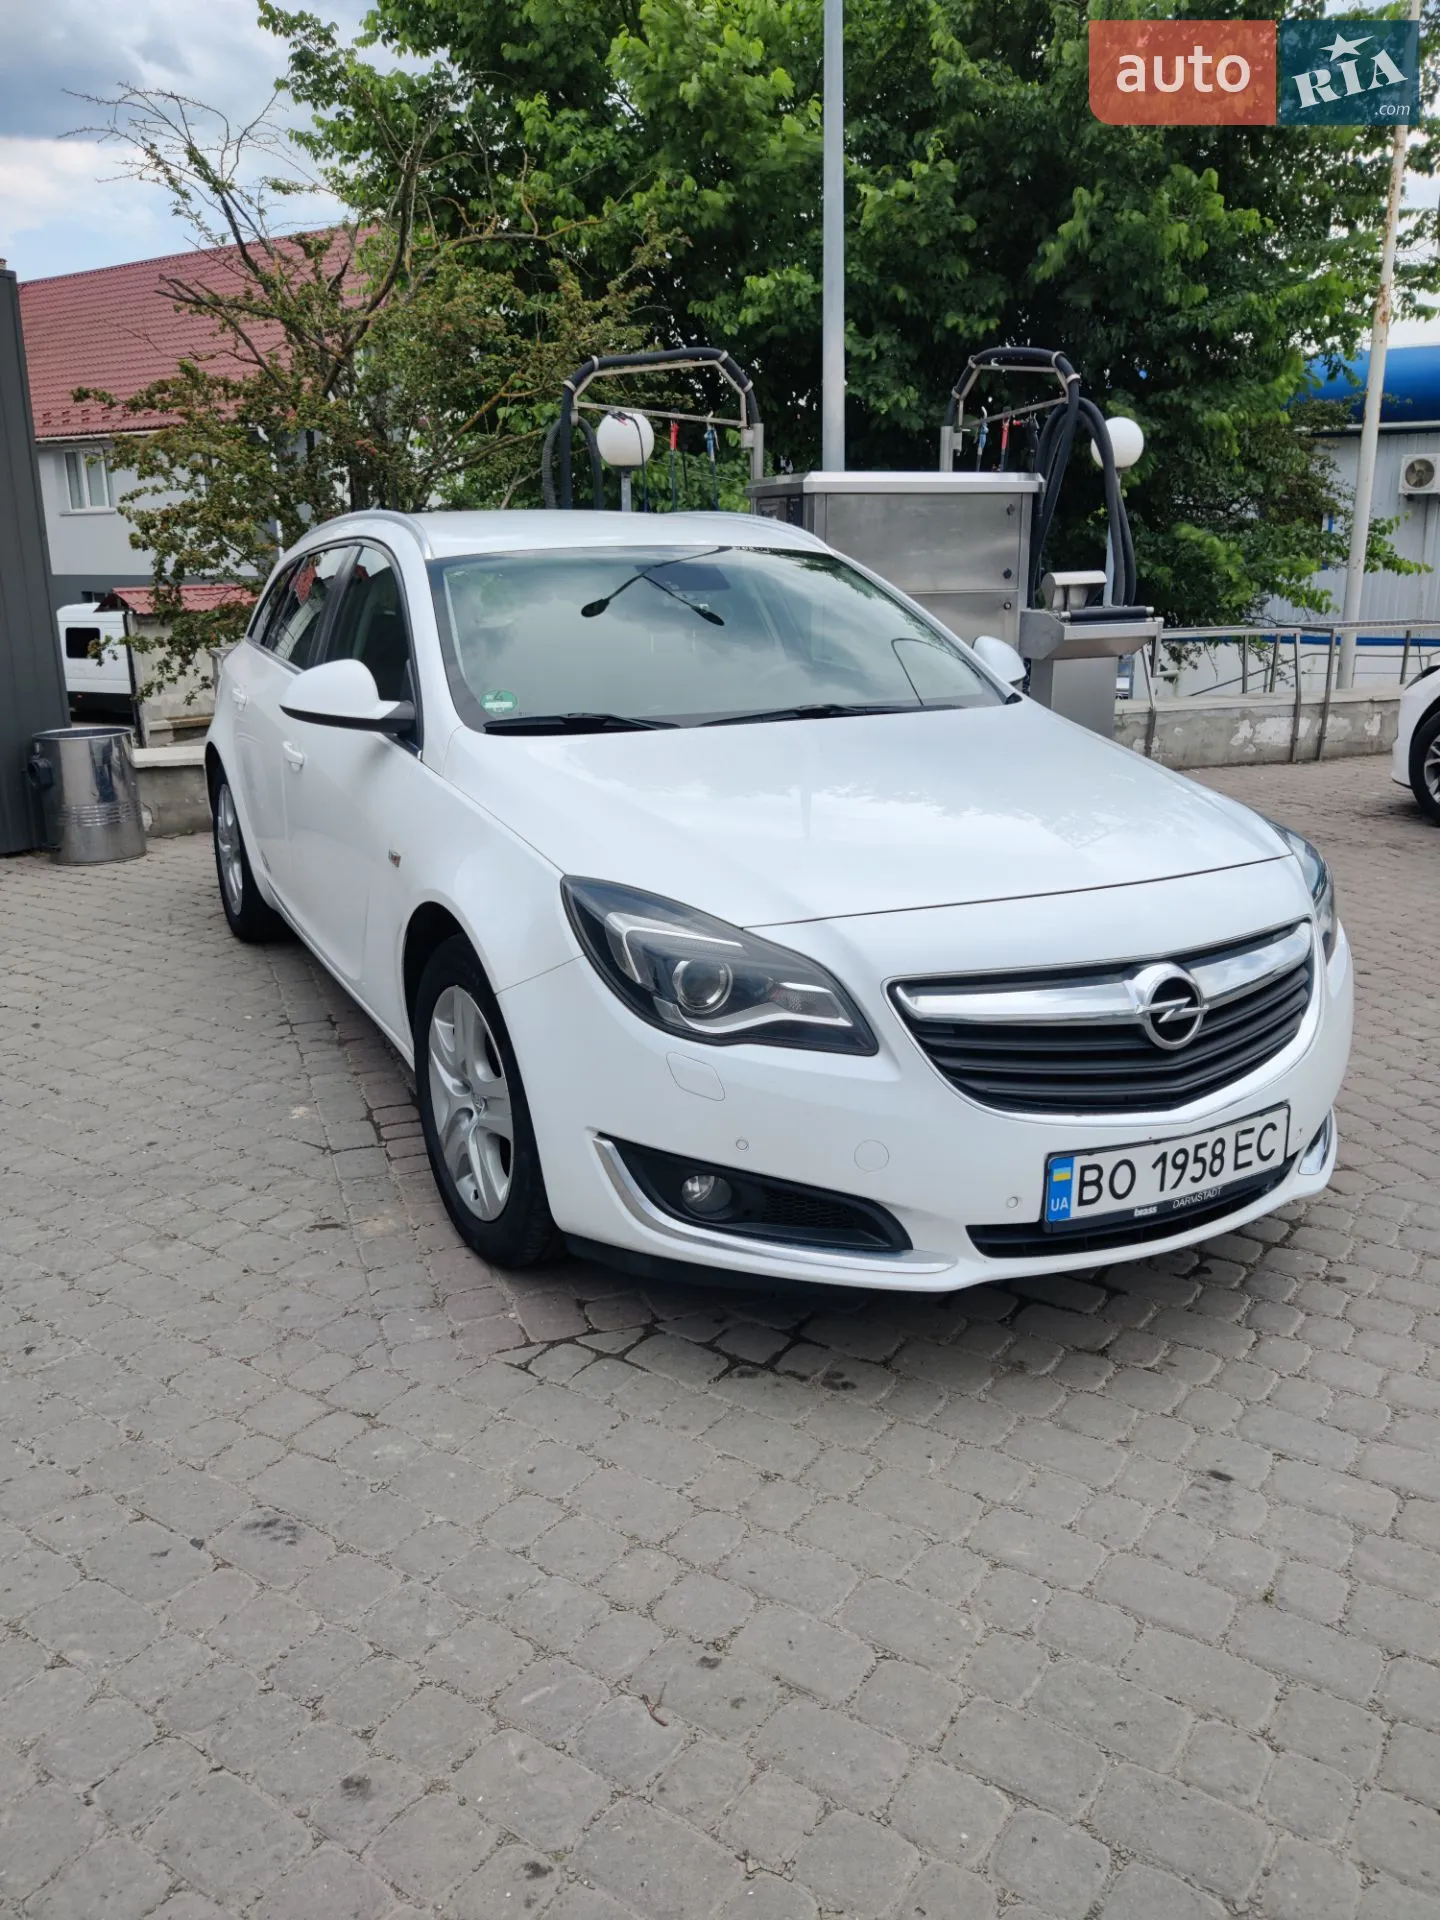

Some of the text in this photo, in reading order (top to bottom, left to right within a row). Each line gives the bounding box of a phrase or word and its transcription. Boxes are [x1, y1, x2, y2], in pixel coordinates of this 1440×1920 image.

[1077, 1122, 1278, 1207] BO 1958 EC
[1051, 1197, 1069, 1212] UA
[1172, 1186, 1223, 1209] DARMSTADT
